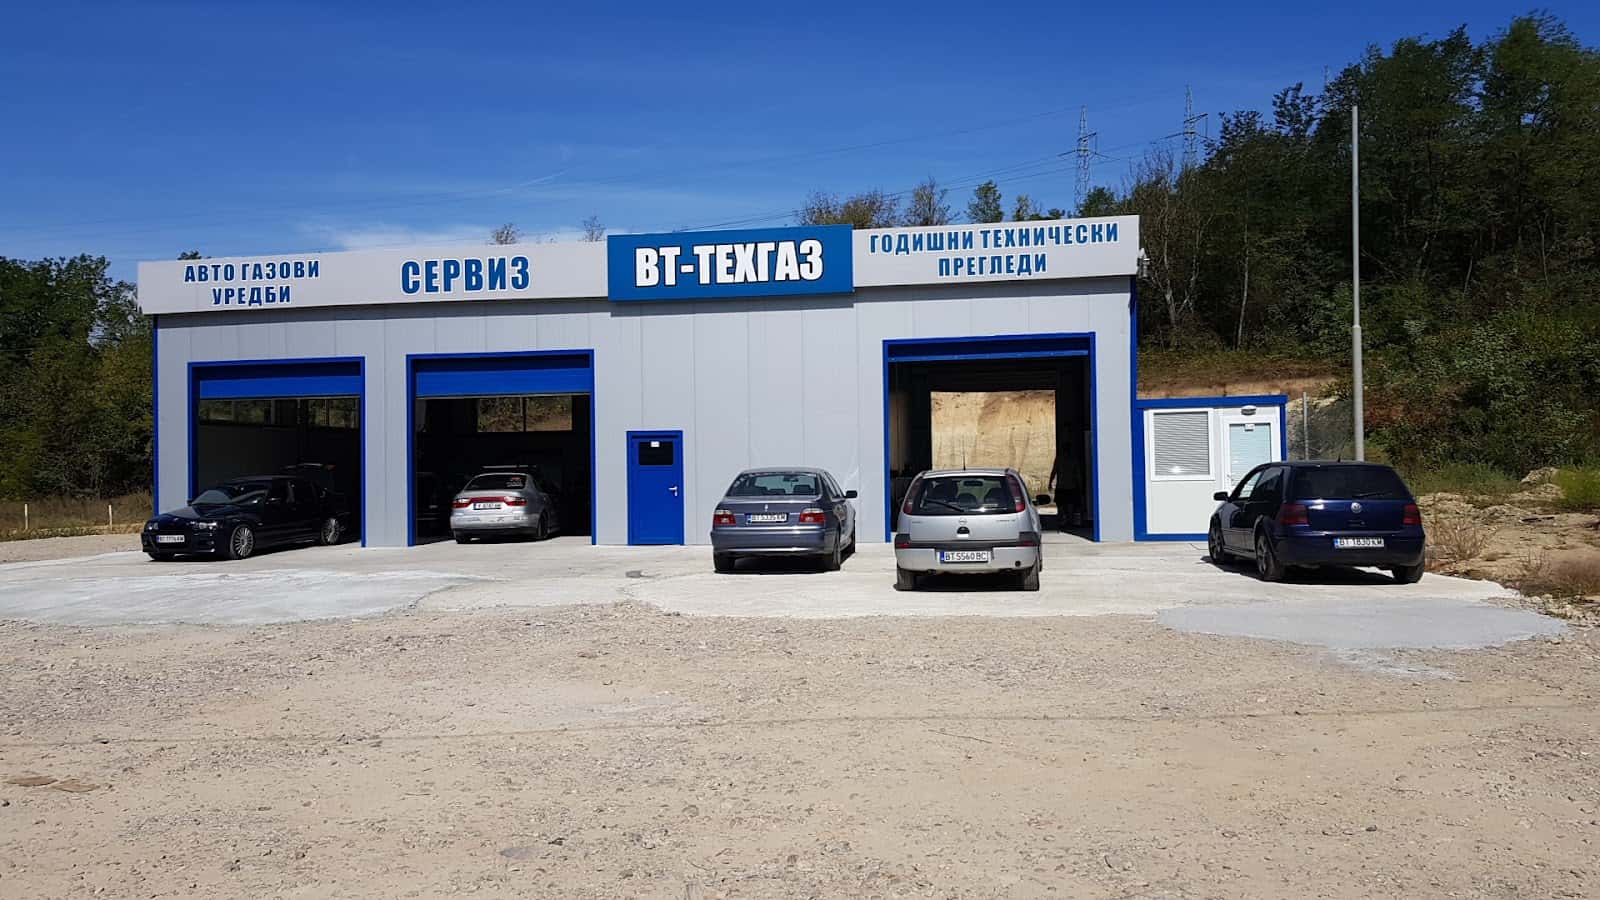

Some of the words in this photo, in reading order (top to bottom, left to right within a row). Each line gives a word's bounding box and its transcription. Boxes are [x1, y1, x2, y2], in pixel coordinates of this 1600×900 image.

[870, 230, 973, 256] ГОДИШНИ
[979, 223, 1118, 249] ТЕХНИЧЕСКИ
[184, 264, 235, 282] АВТО
[241, 260, 319, 281] ГАЗОВИ
[401, 256, 530, 294] СЕРВИЗ
[635, 239, 824, 287] ВТ-ТЕХГАЗ
[938, 253, 1047, 276] ПРЕГЛЕДИ
[212, 285, 291, 306] УРЕДБИ
